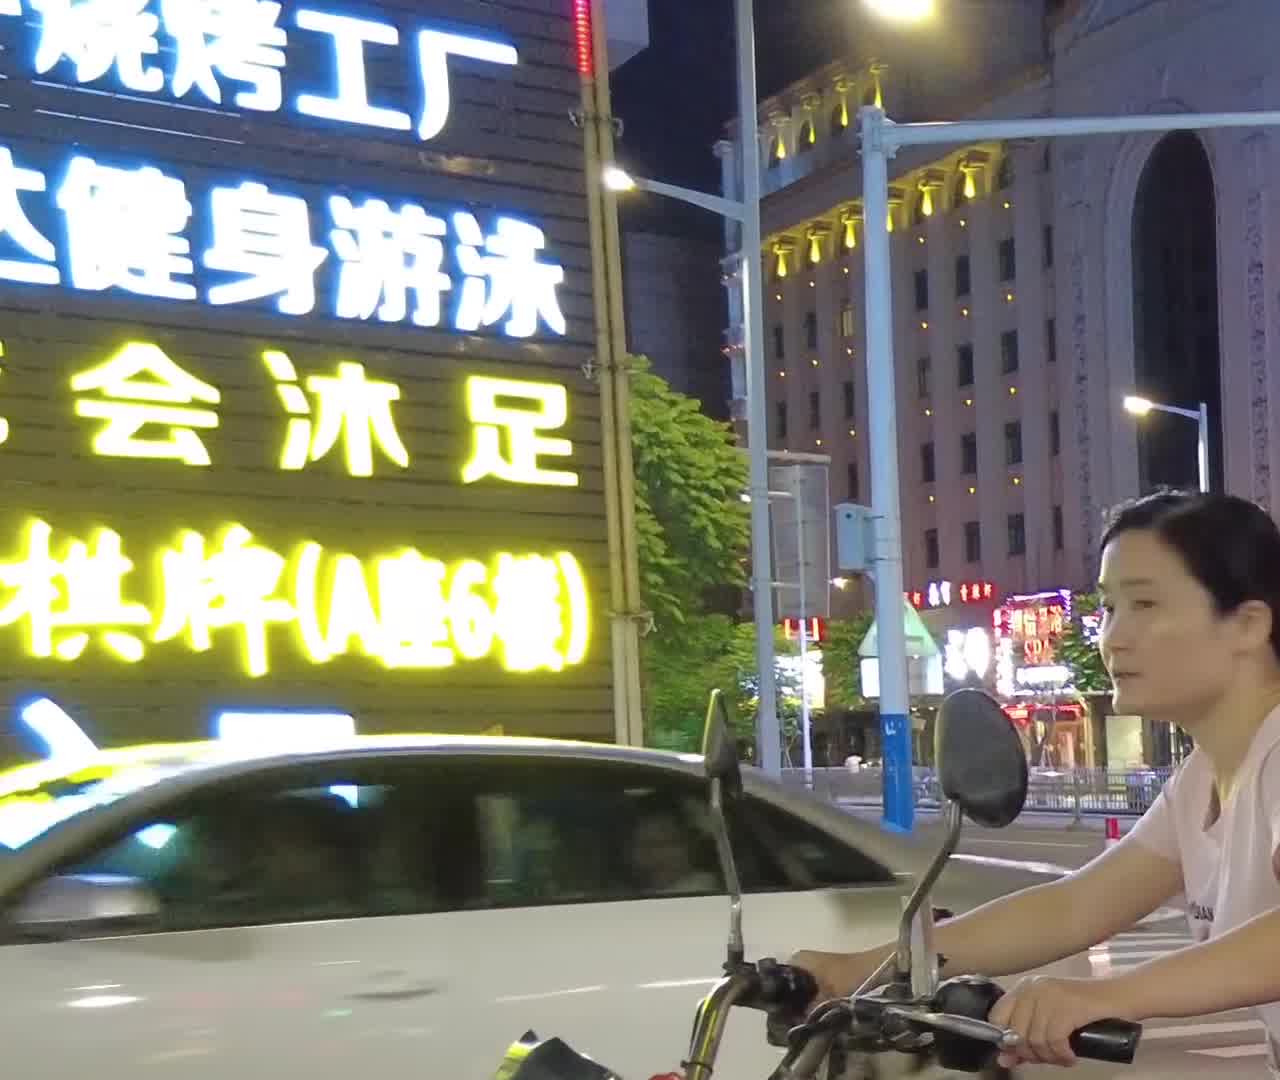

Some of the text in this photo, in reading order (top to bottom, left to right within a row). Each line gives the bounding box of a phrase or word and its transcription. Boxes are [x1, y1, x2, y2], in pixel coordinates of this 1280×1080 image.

[0, 0, 518, 142] 烧烤工厂
[0, 341, 579, 486] 会沐足
